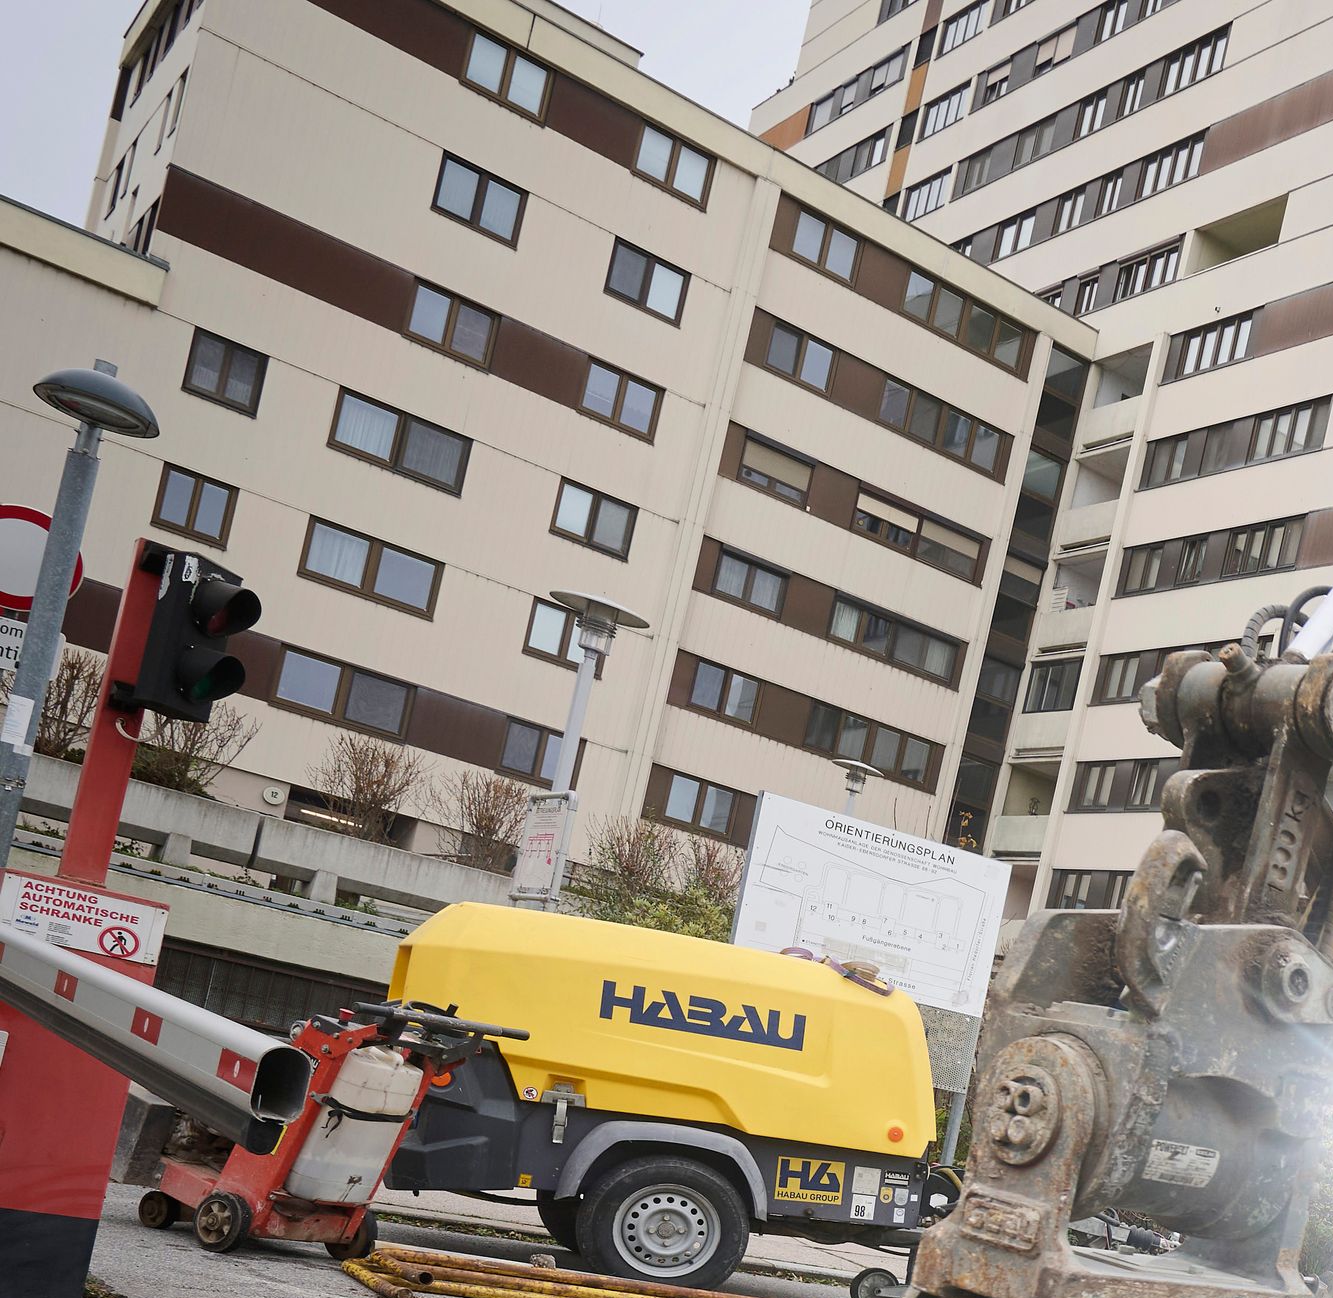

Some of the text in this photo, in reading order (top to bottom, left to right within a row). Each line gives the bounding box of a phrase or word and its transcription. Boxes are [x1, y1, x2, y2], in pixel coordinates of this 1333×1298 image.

[271, 790, 279, 799] 12
[824, 819, 956, 865] ORIENTIERUNGSPLAN
[23, 881, 99, 905] ACHTUNG
[18, 902, 104, 927] SCHRANKE
[21, 891, 140, 925] AUTOMATISCHE
[599, 979, 807, 1052] HABAU
[777, 1191, 840, 1203] HABAU GROUP
[854, 1204, 866, 1218] 98
